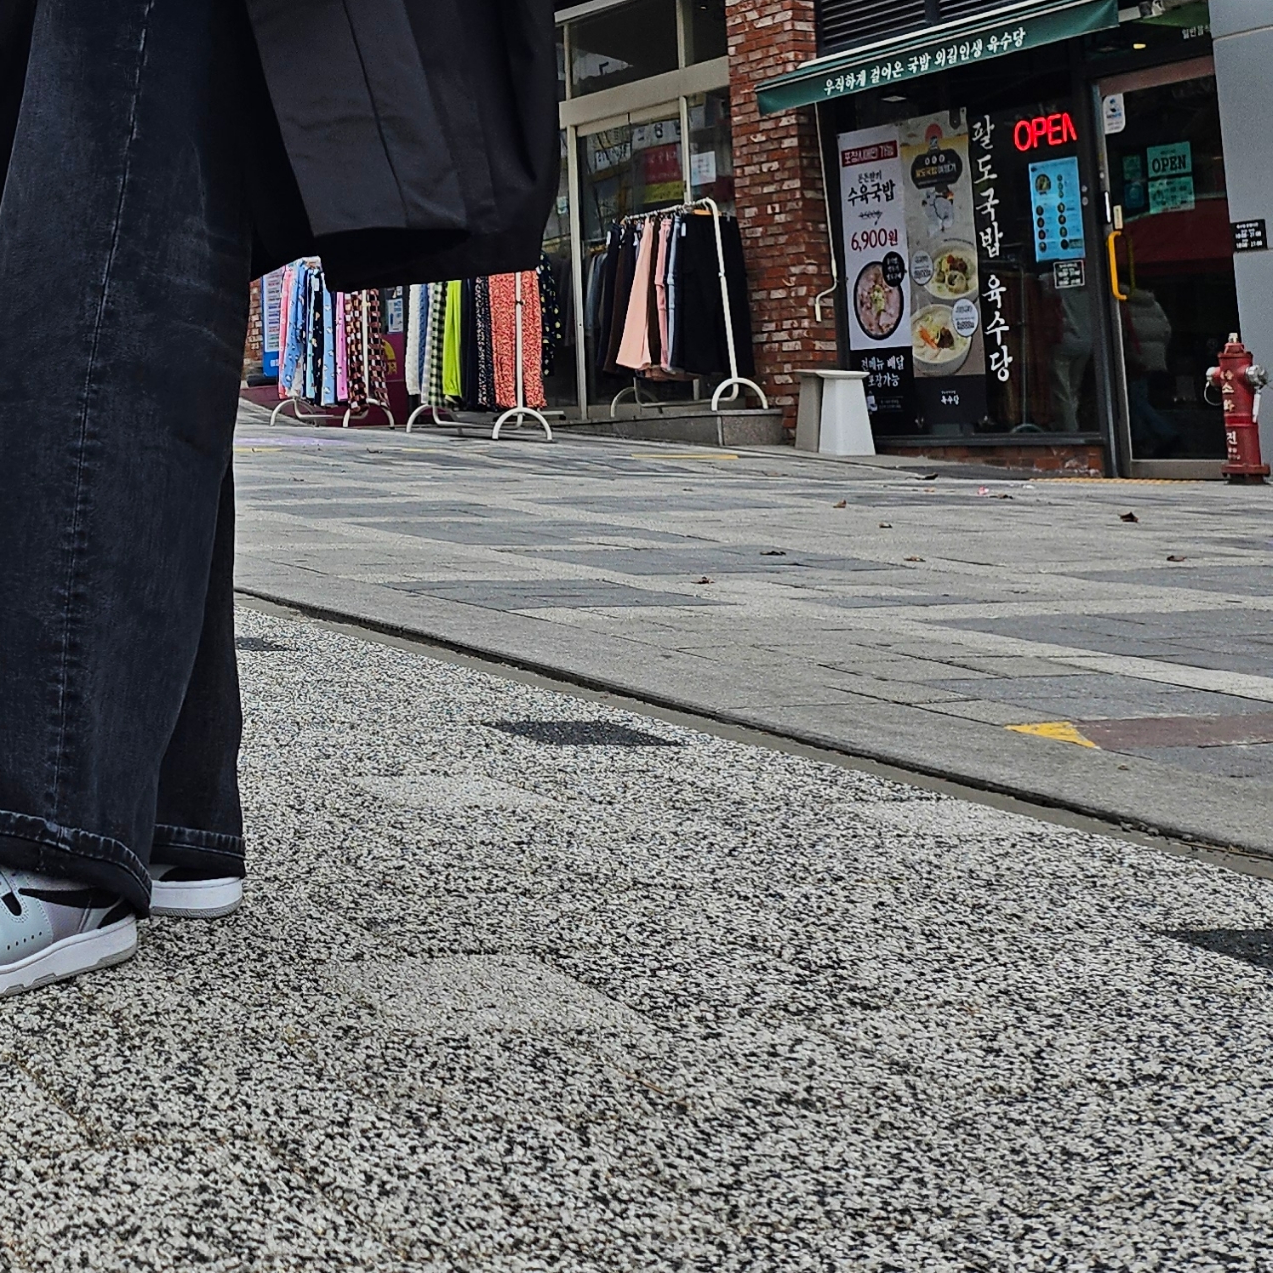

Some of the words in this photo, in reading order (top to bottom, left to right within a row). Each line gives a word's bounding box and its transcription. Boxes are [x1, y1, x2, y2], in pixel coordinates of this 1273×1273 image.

[824, 70, 867, 96] 우직하게
[870, 60, 905, 83] 걸어온
[907, 52, 932, 73] 국밥
[934, 38, 984, 67] 외길인생
[987, 27, 1027, 53] 육수당
[1014, 112, 1077, 151] OPEN
[1152, 155, 1186, 173] OPEN
[847, 179, 896, 207] 수육국밥
[971, 114, 1004, 259] 팔도국밥
[851, 228, 898, 252] 6,900원
[982, 274, 1013, 382] 육수당
[861, 356, 885, 372] 전메뉴
[887, 354, 905, 370] 배달
[868, 372, 901, 388] 포장가능
